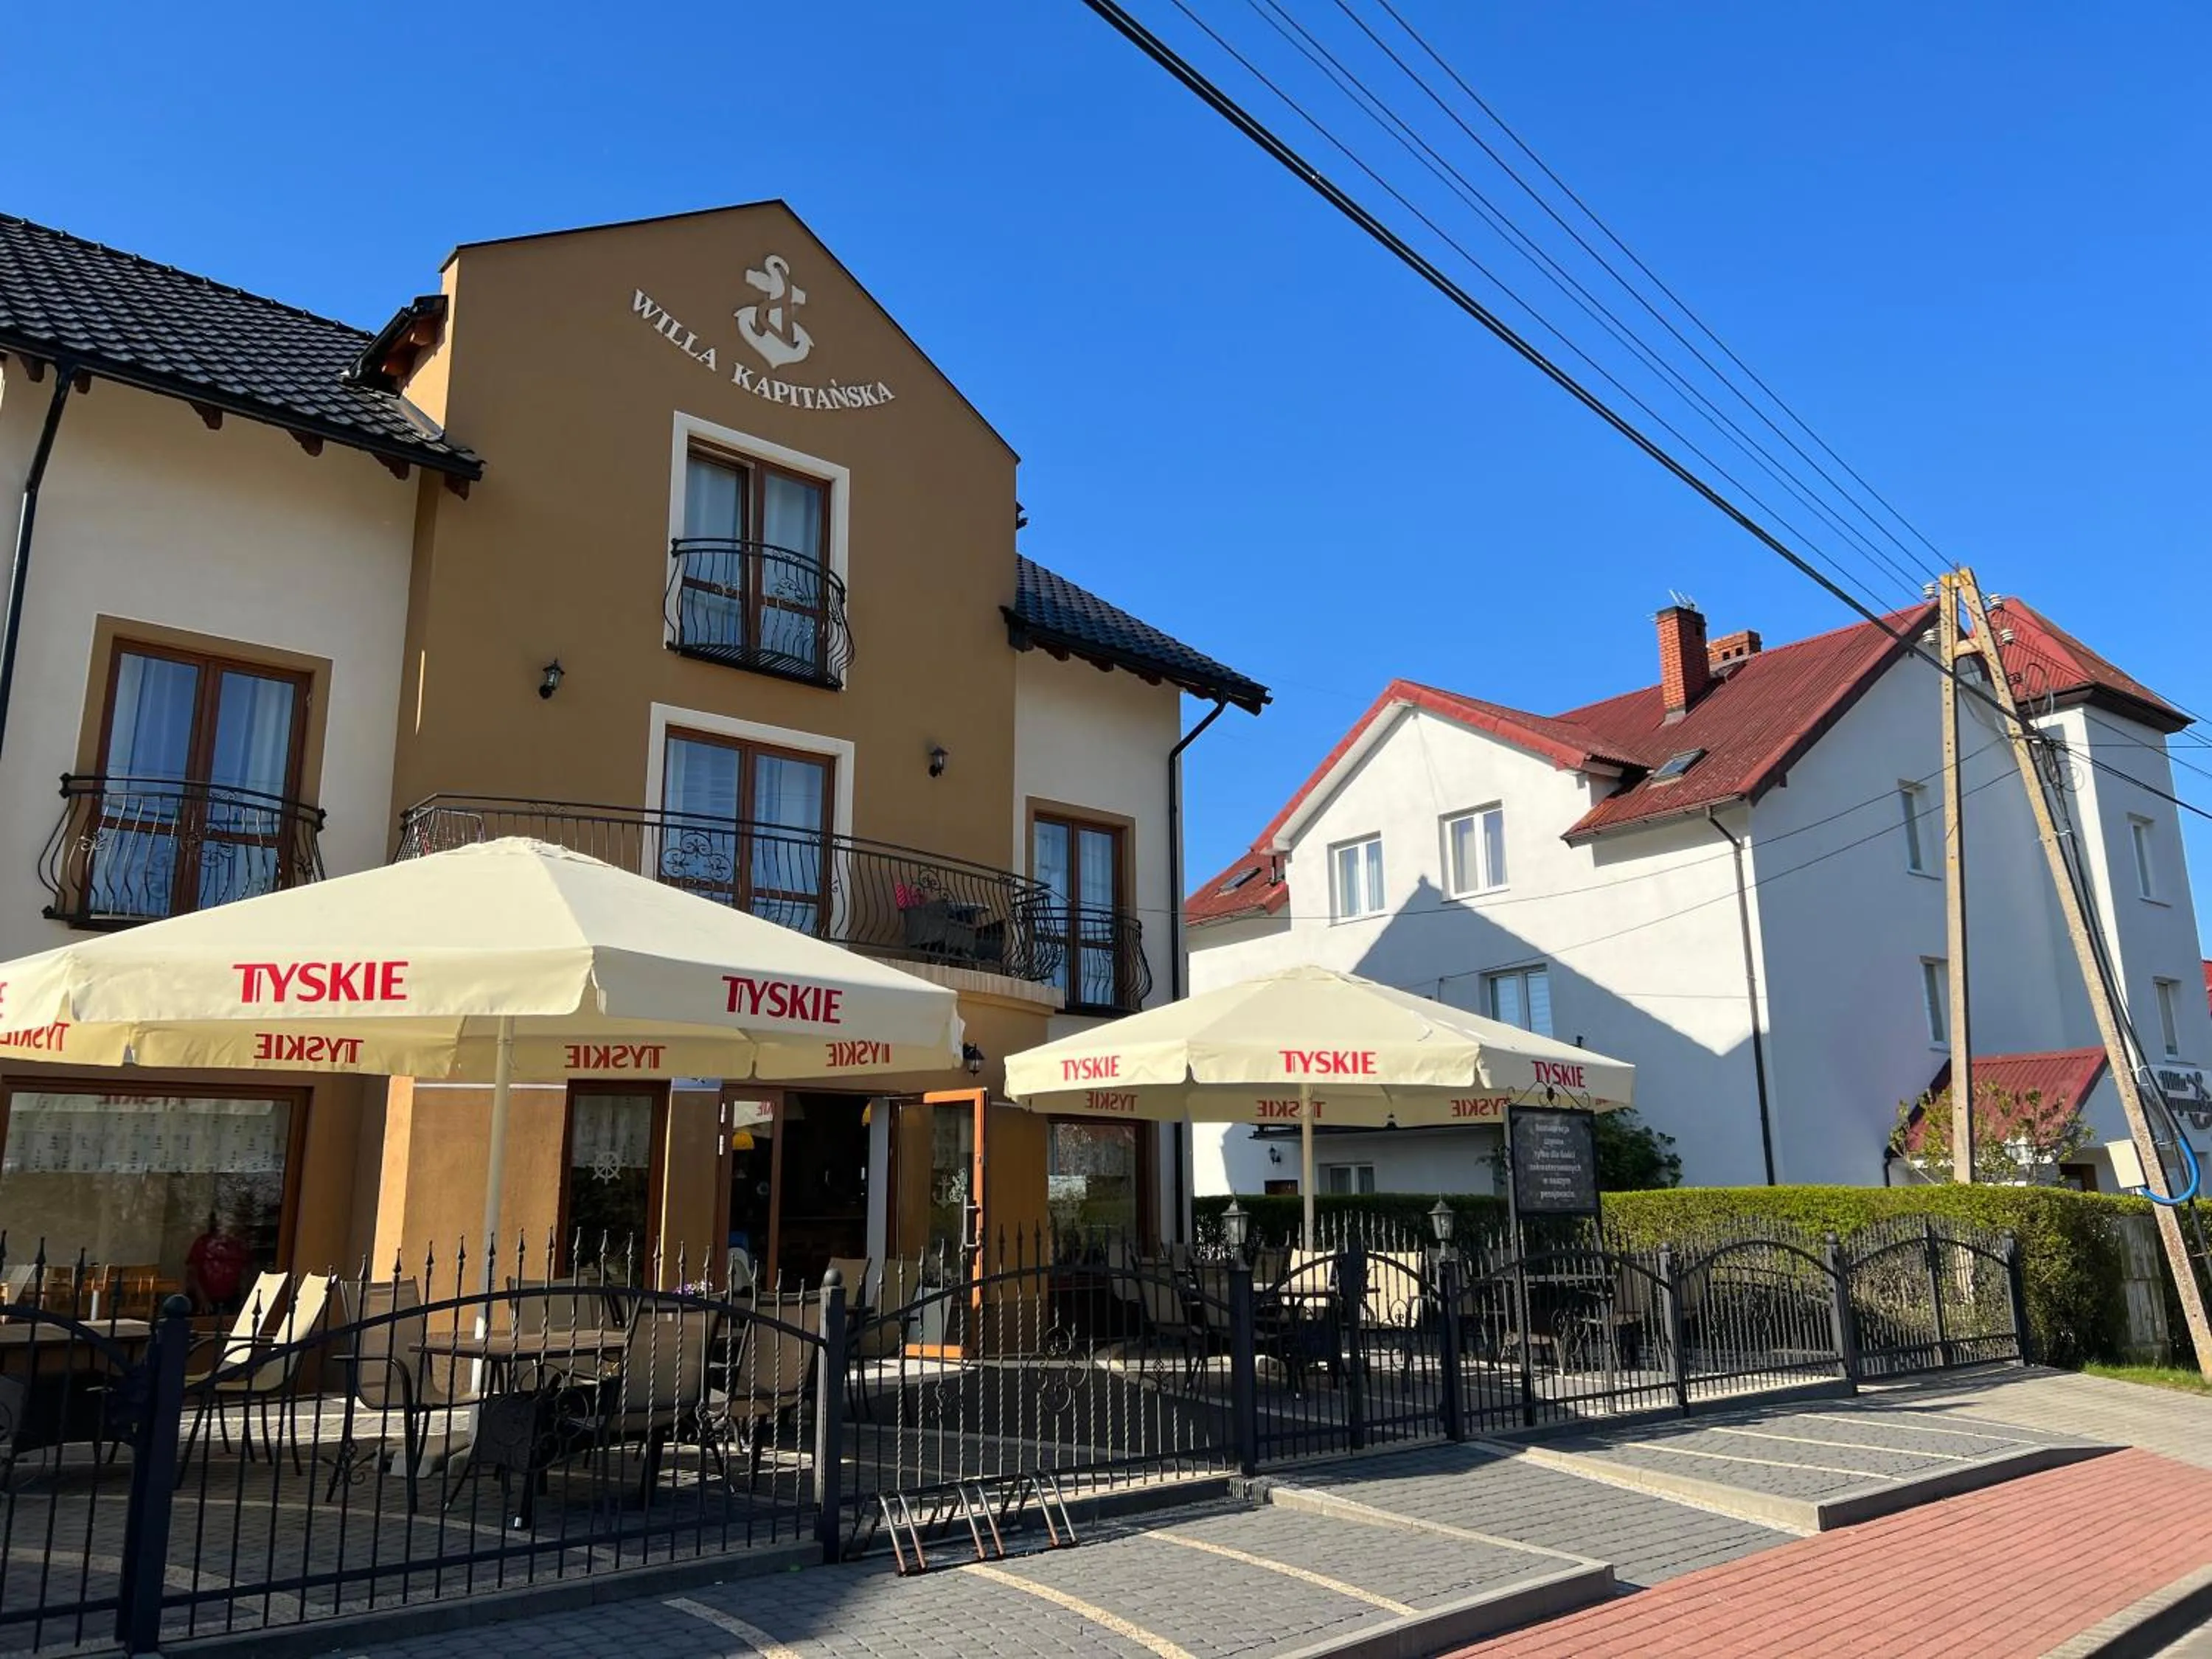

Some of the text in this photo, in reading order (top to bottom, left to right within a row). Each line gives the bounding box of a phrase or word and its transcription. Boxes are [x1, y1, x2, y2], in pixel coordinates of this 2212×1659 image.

[632, 288, 895, 410] WILLA KAPITAŃSKA
[233, 961, 409, 1004] TYSKIE
[722, 975, 843, 1024] TYSKIE
[1060, 1055, 1120, 1082] TYSKIE
[1279, 1051, 1377, 1074] TYSKIE
[1531, 1060, 1586, 1088] TYSKIE
